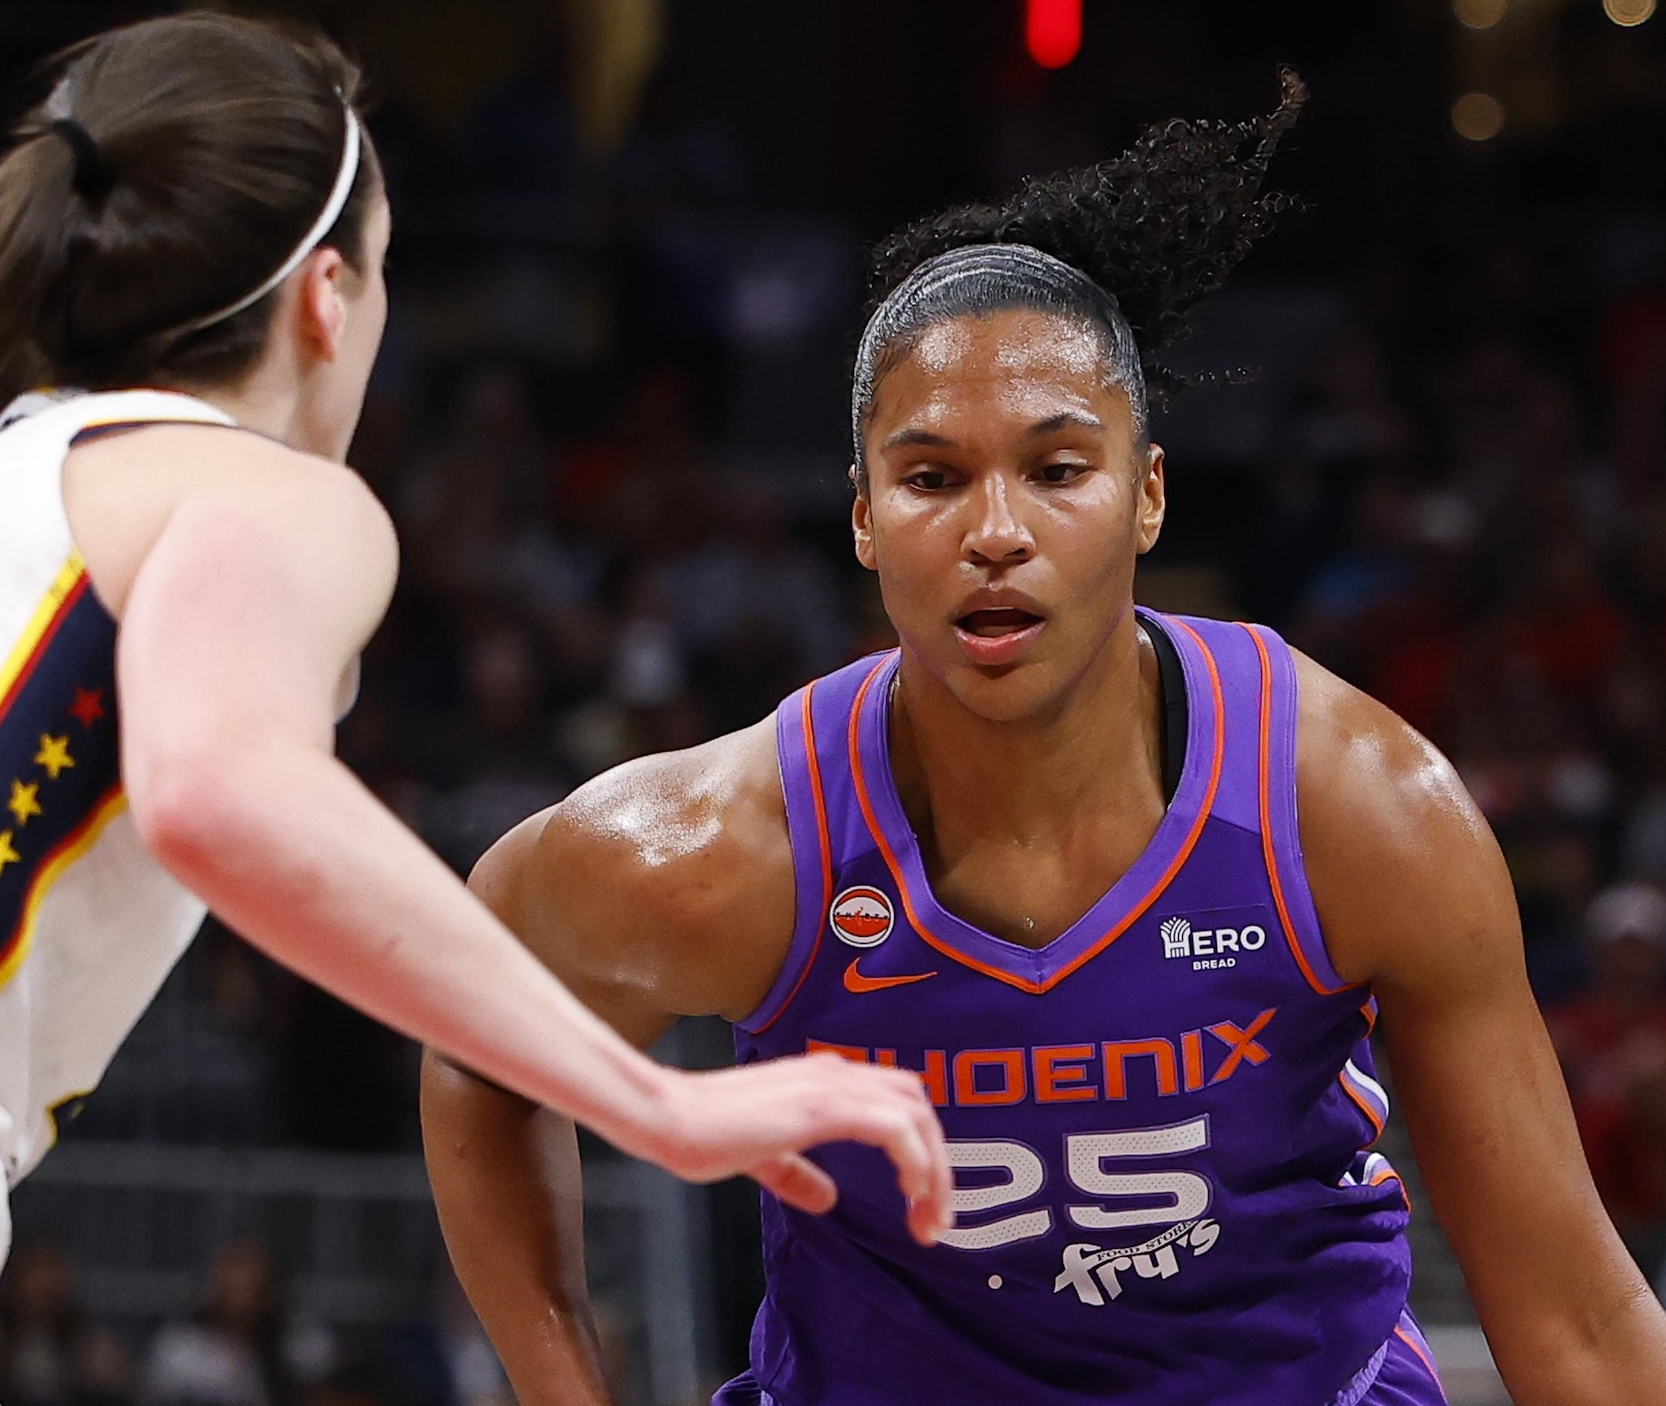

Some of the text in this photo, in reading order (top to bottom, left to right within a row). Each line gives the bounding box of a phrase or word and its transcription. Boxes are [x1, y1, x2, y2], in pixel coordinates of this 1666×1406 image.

[1160, 916, 1266, 959] HERO
[1193, 958, 1236, 971] BREAD
[931, 1113, 1213, 1251] 25
[1096, 1246, 1141, 1262] FOOD
